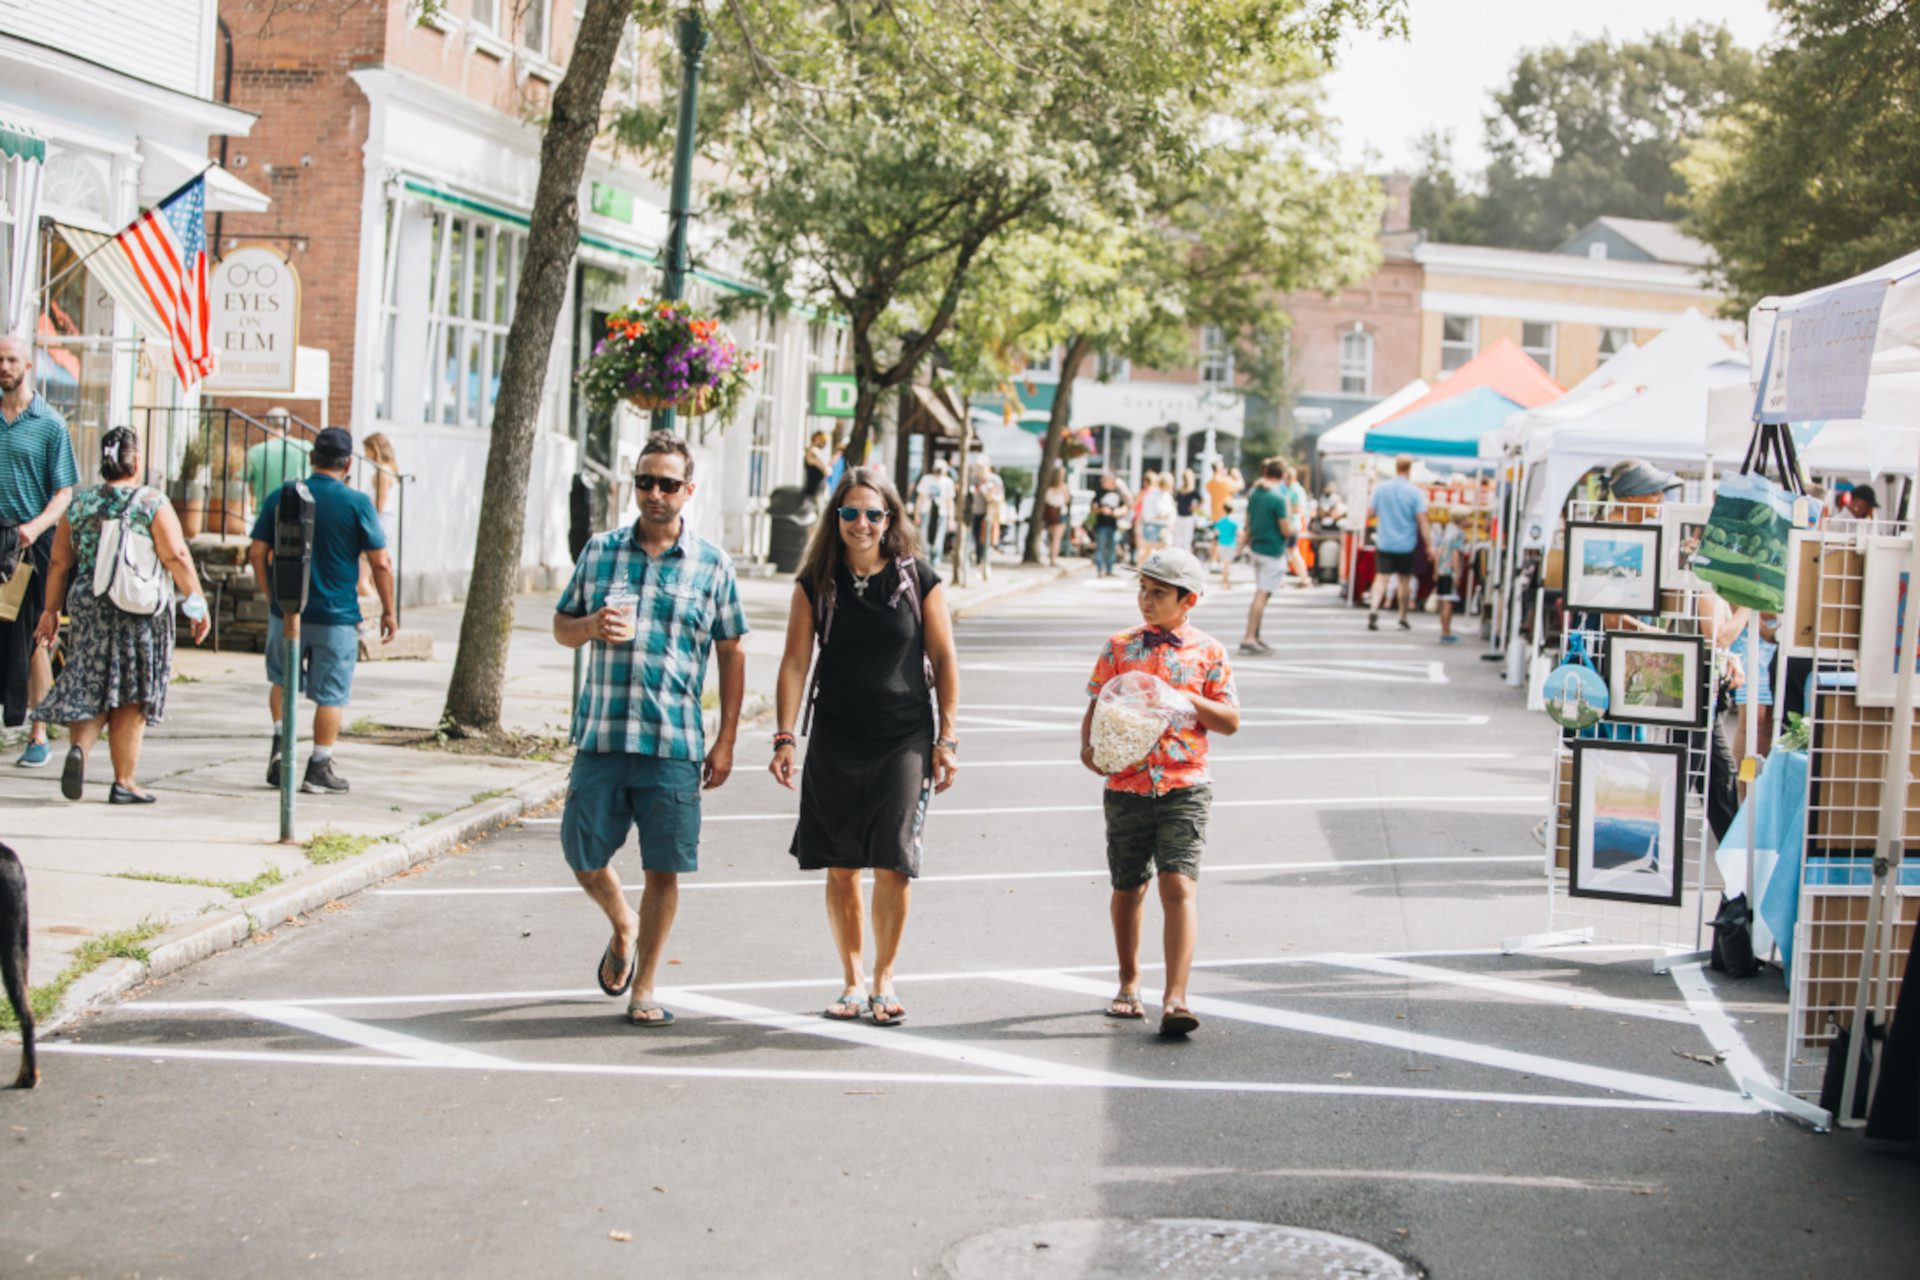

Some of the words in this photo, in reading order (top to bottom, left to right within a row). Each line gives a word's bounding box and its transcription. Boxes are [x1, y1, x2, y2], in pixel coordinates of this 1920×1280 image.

[224, 293, 280, 313] EYES
[239, 317, 261, 328] ON
[224, 331, 275, 352] ELM
[820, 381, 858, 409] TD
